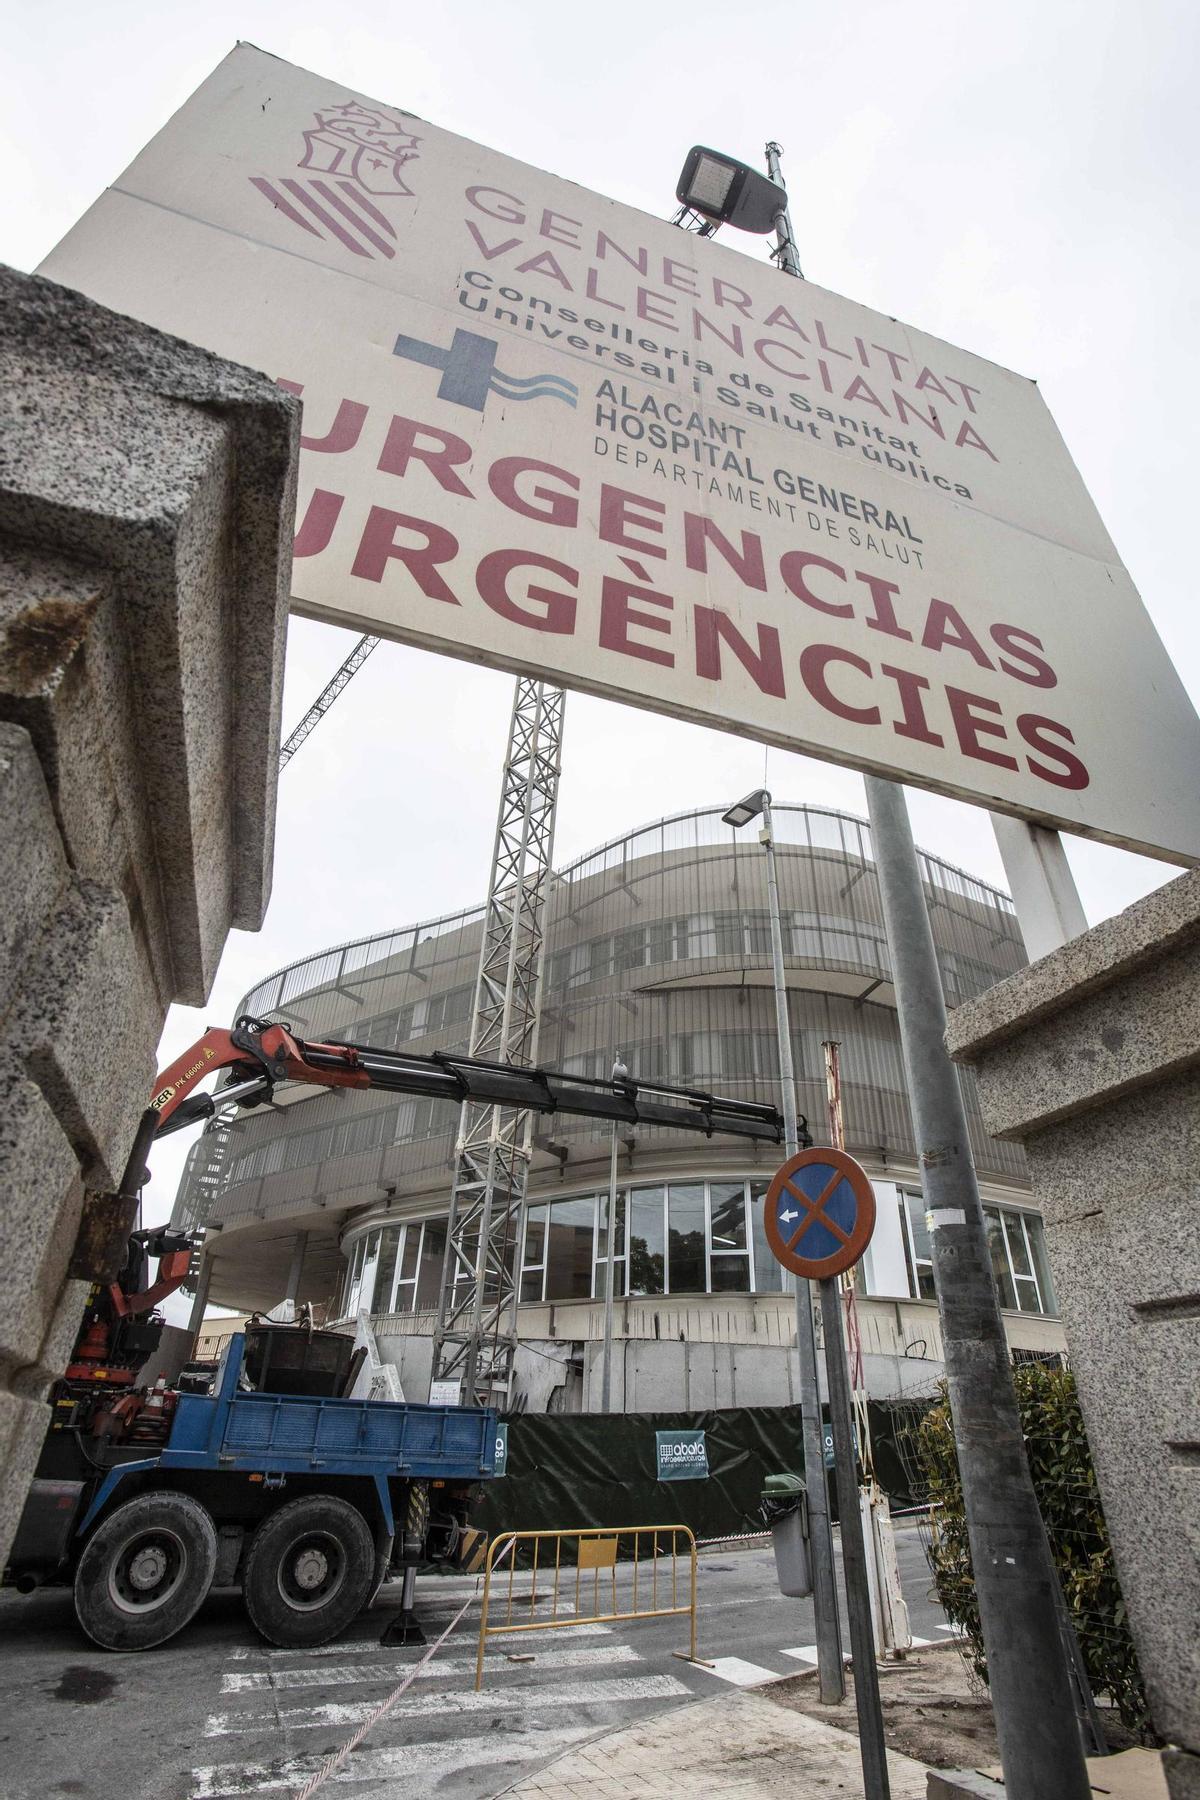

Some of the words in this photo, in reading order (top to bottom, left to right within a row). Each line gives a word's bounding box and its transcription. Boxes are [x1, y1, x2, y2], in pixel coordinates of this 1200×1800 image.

[463, 270, 714, 376] Conselleria
[729, 371, 775, 398] de
[788, 394, 921, 458] Sanitat
[464, 219, 1000, 463] VALENCIANA
[465, 185, 980, 413] GENERALITAT
[458, 290, 675, 384] Universal
[693, 377, 700, 395] i
[717, 387, 820, 440] Salut
[835, 434, 974, 500] Pública
[595, 379, 746, 449] ALACANT
[595, 404, 764, 485] HOSPITAL
[773, 468, 924, 543] GENERAL
[276, 377, 1058, 689] URGENCIAS
[594, 437, 797, 523] DEPARTAMENT
[808, 511, 838, 539] DE
[850, 525, 925, 570] SALUT
[175, 1078, 186, 1089] PK
[185, 1060, 205, 1079] 66000
